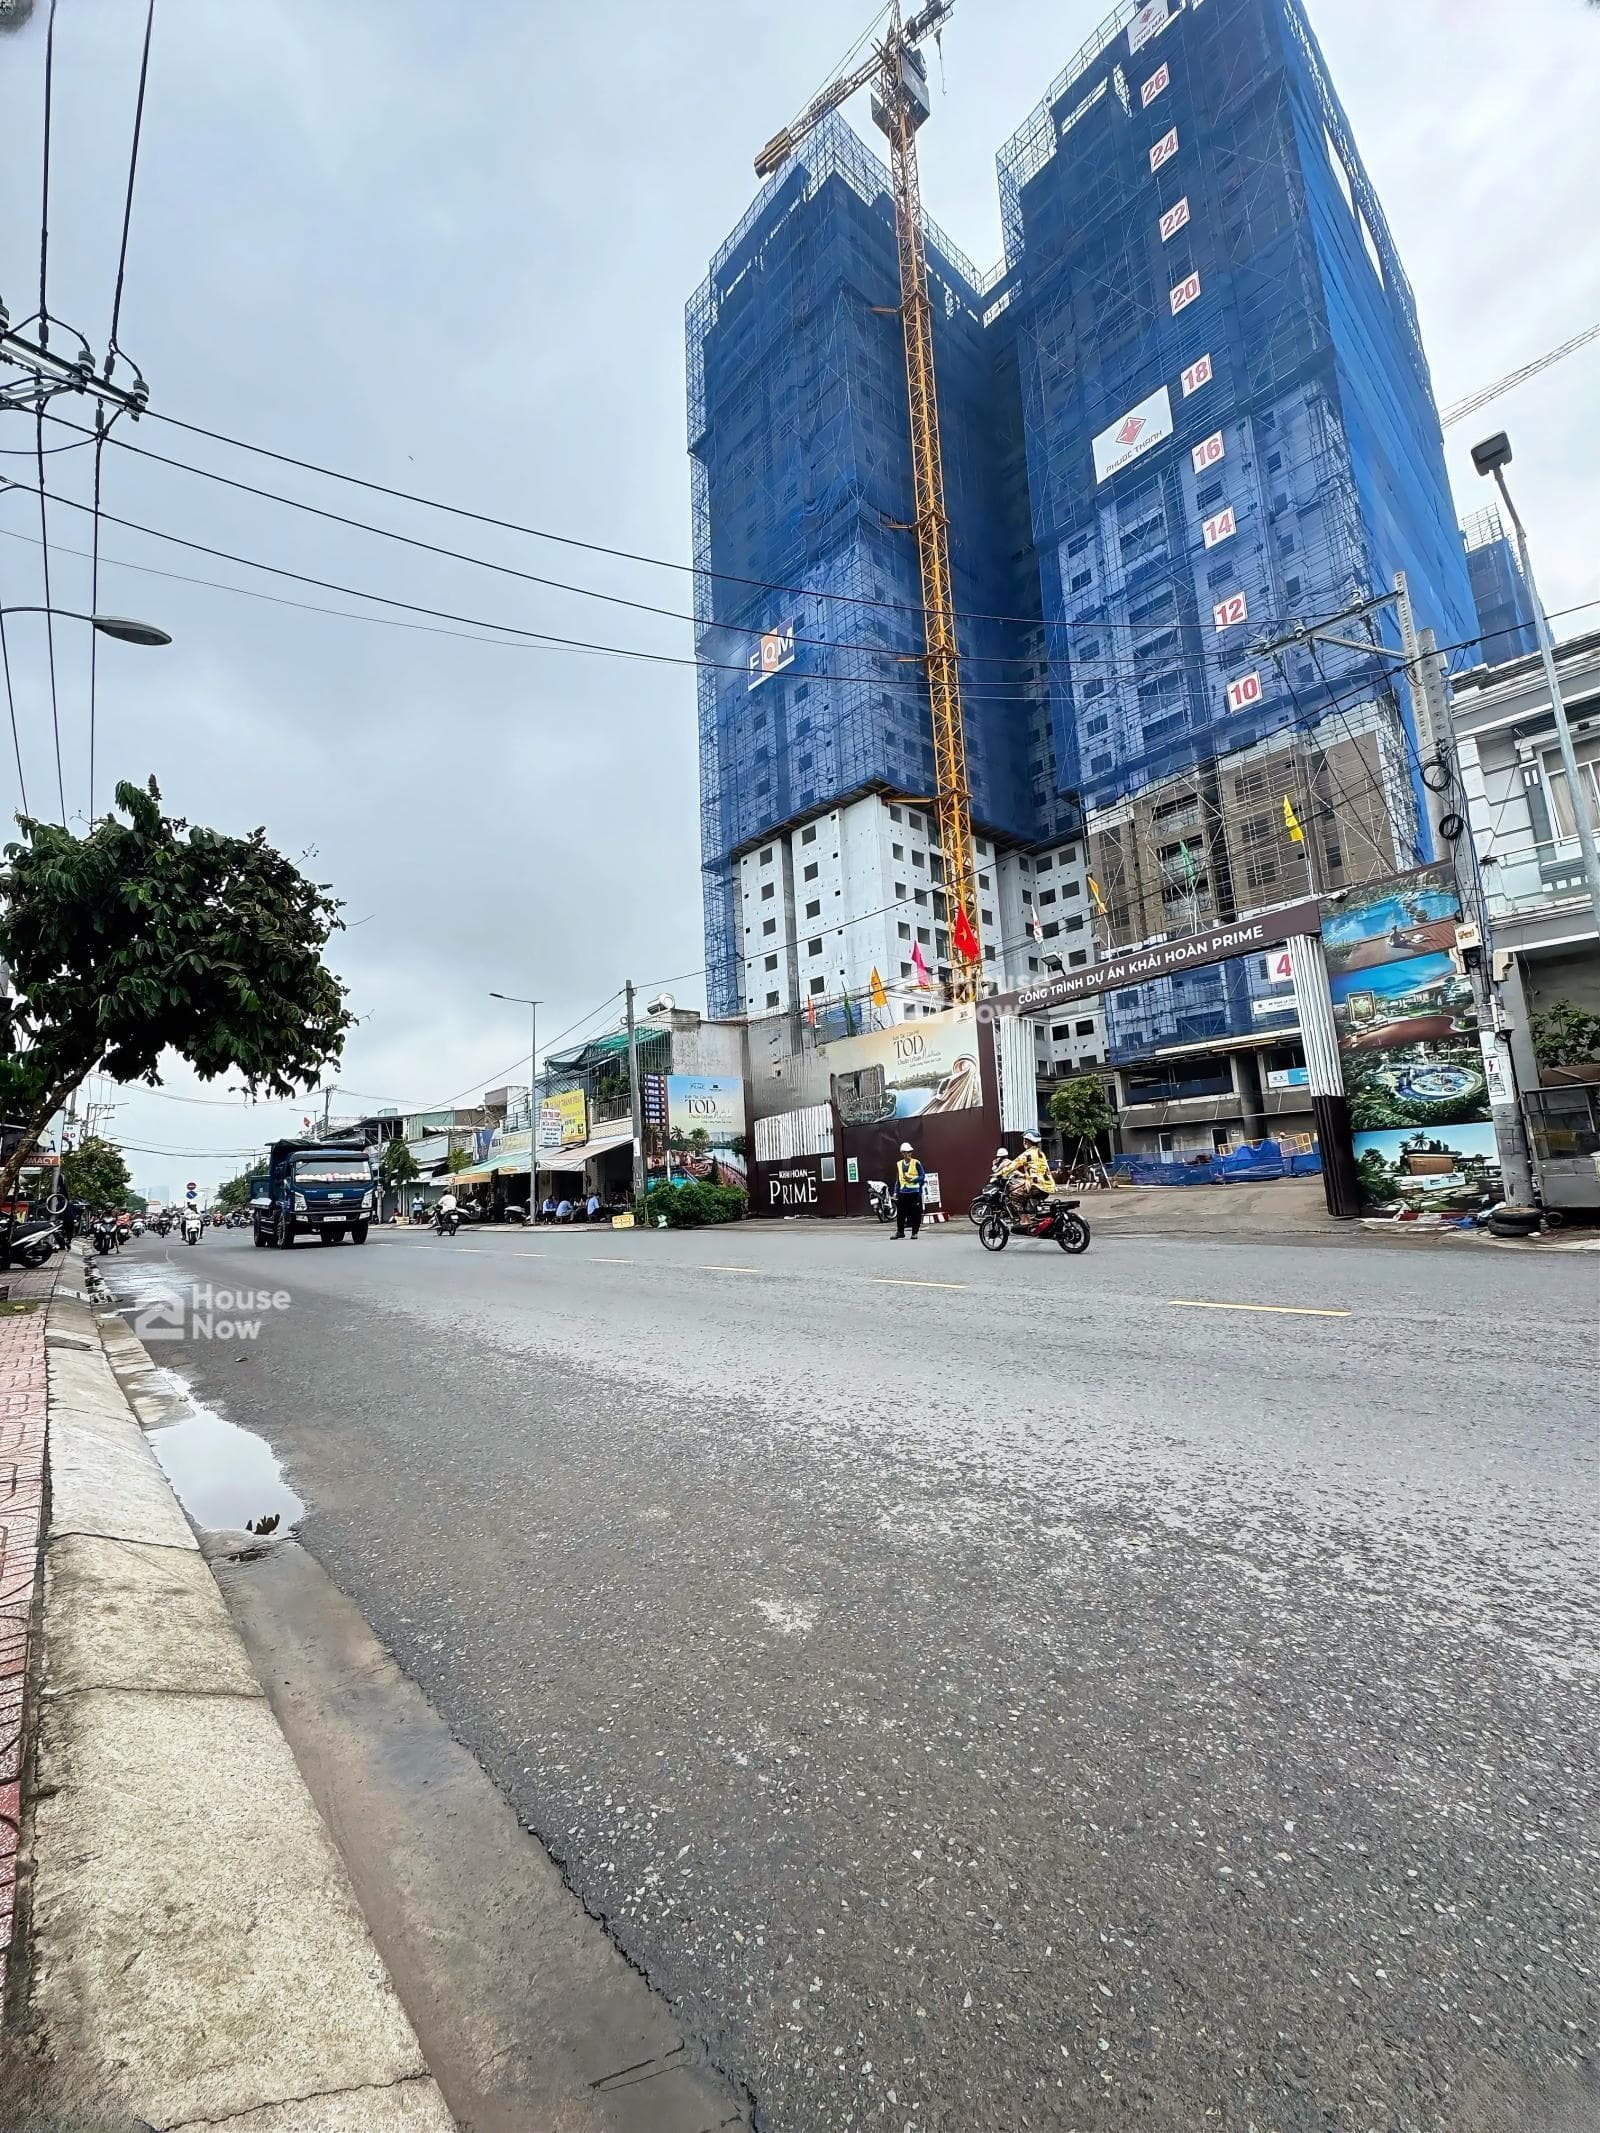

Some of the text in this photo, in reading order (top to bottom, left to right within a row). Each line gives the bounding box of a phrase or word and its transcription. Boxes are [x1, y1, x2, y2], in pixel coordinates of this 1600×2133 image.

[1143, 69, 1167, 103] 26
[1153, 134, 1176, 167] 24
[1163, 204, 1187, 236] 22
[1173, 278, 1198, 309] 20
[1184, 361, 1209, 390] 18
[1195, 438, 1221, 466] 16
[1206, 512, 1233, 541] 14
[1217, 598, 1244, 626] 12
[1230, 677, 1258, 705] 10
[1018, 924, 1264, 1005] CÔNG TRÌNH DỰ ÁN KHẢI HOÀN PRIME
[1276, 954, 1292, 977] 4
[893, 1035, 924, 1059] TOD
[684, 1099, 716, 1114] TOD
